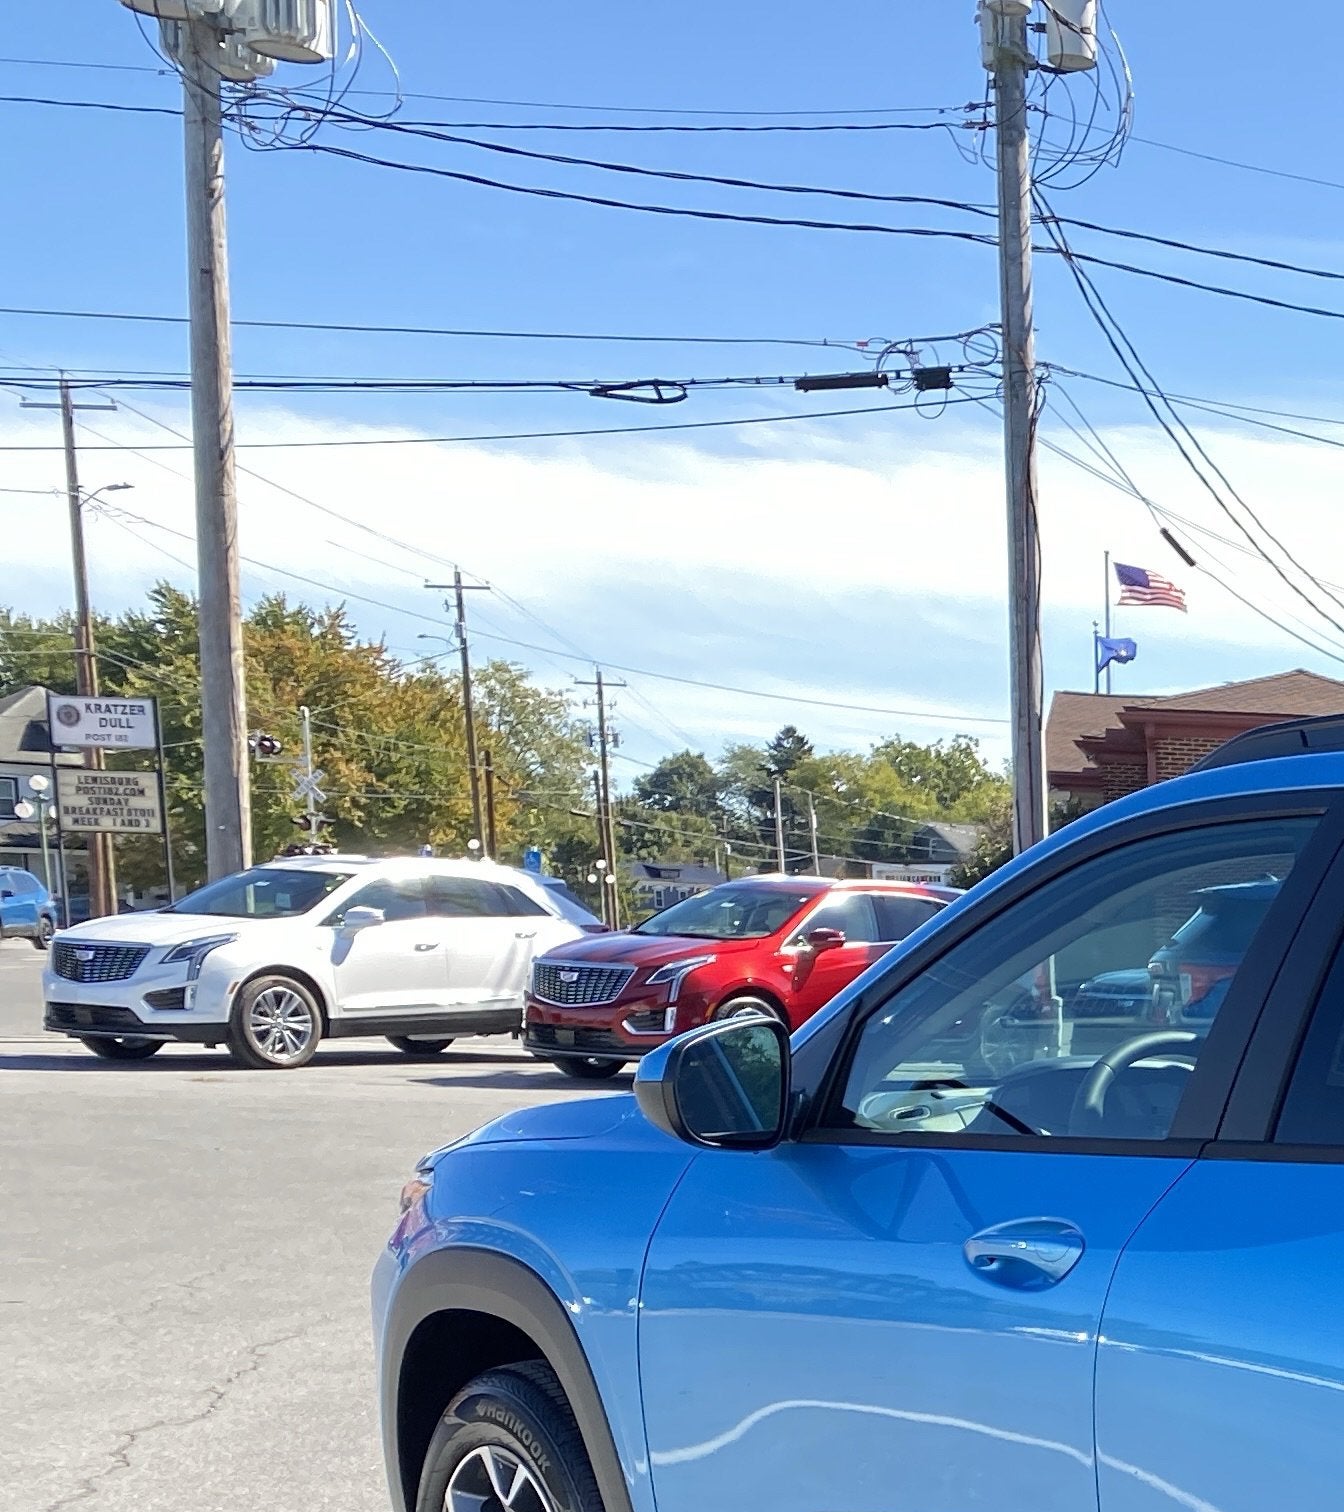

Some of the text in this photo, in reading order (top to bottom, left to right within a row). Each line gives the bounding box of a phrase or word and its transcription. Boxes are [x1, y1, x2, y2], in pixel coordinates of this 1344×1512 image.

[84, 703, 146, 716] KRATZER
[99, 717, 135, 729] DULL
[85, 733, 112, 741] POST
[76, 775, 139, 786] LEWISBURG
[87, 796, 130, 806] SUNDAY
[63, 806, 124, 816] BREAKFAST
[72, 817, 101, 826] WEEK
[120, 818, 141, 828] AND
